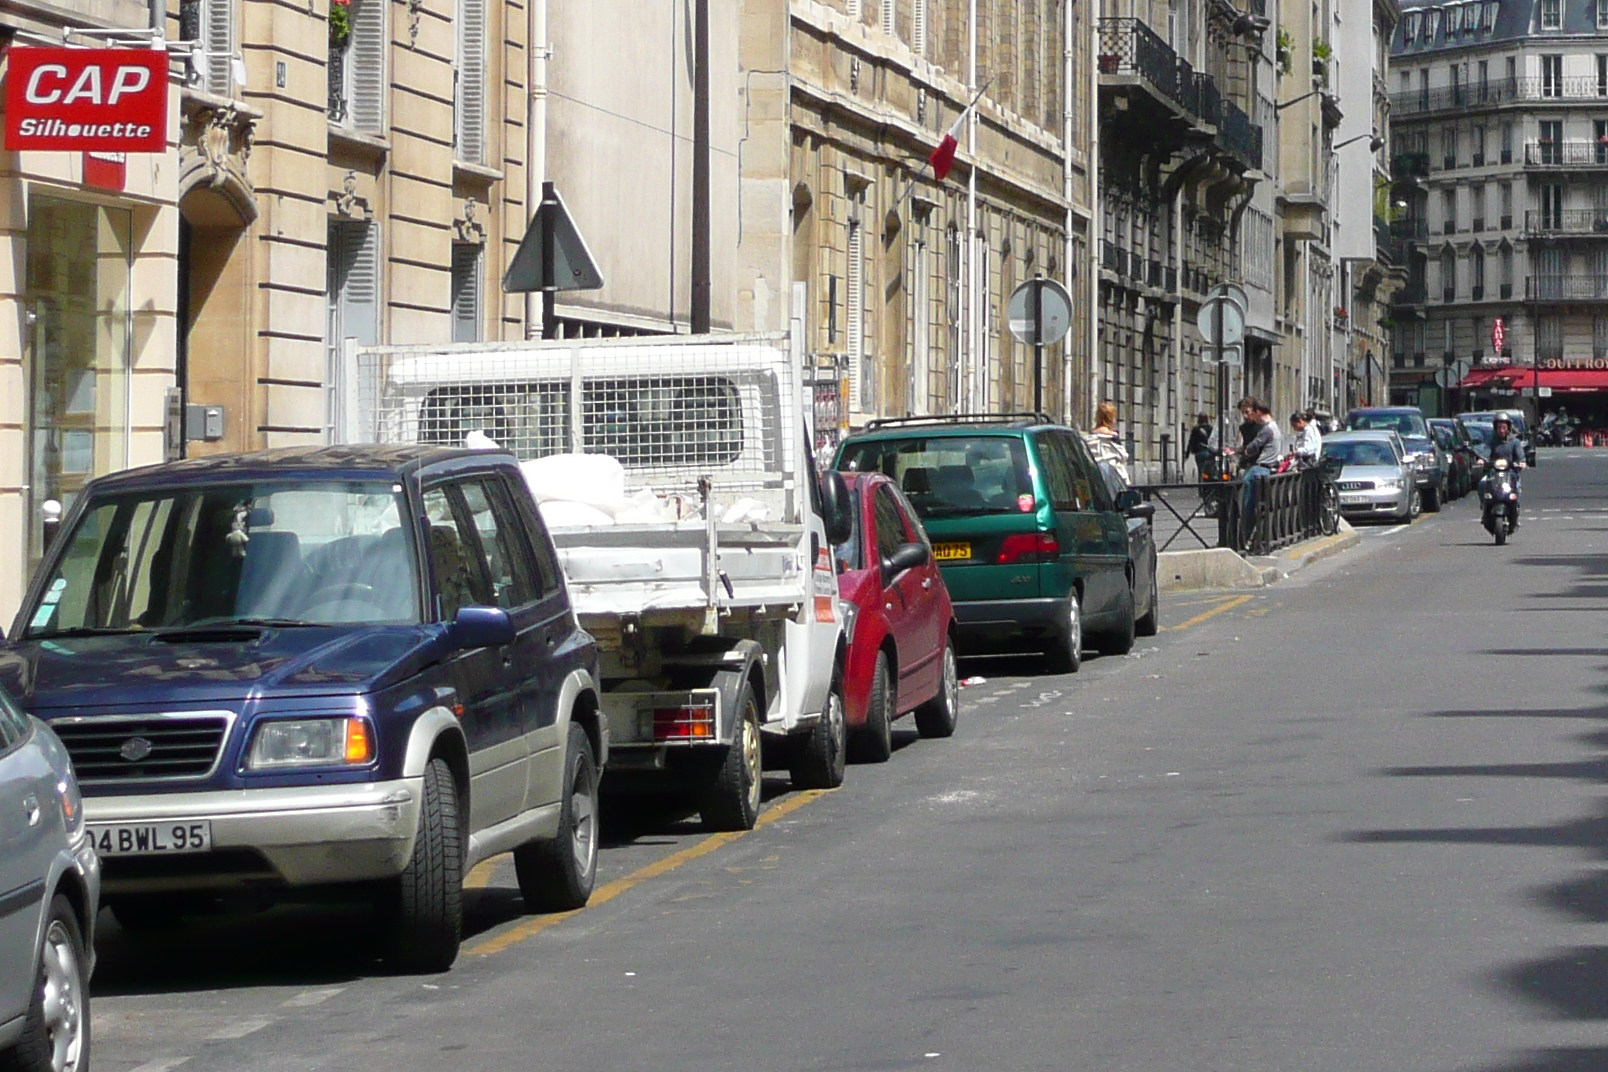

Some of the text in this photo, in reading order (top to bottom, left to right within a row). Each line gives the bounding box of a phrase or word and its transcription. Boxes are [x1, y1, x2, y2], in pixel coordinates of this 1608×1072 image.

[25, 64, 150, 106] CAP
[19, 118, 151, 139] Silhouette
[952, 543, 967, 557] 75
[118, 827, 167, 852] BWL
[172, 824, 205, 850] 95
